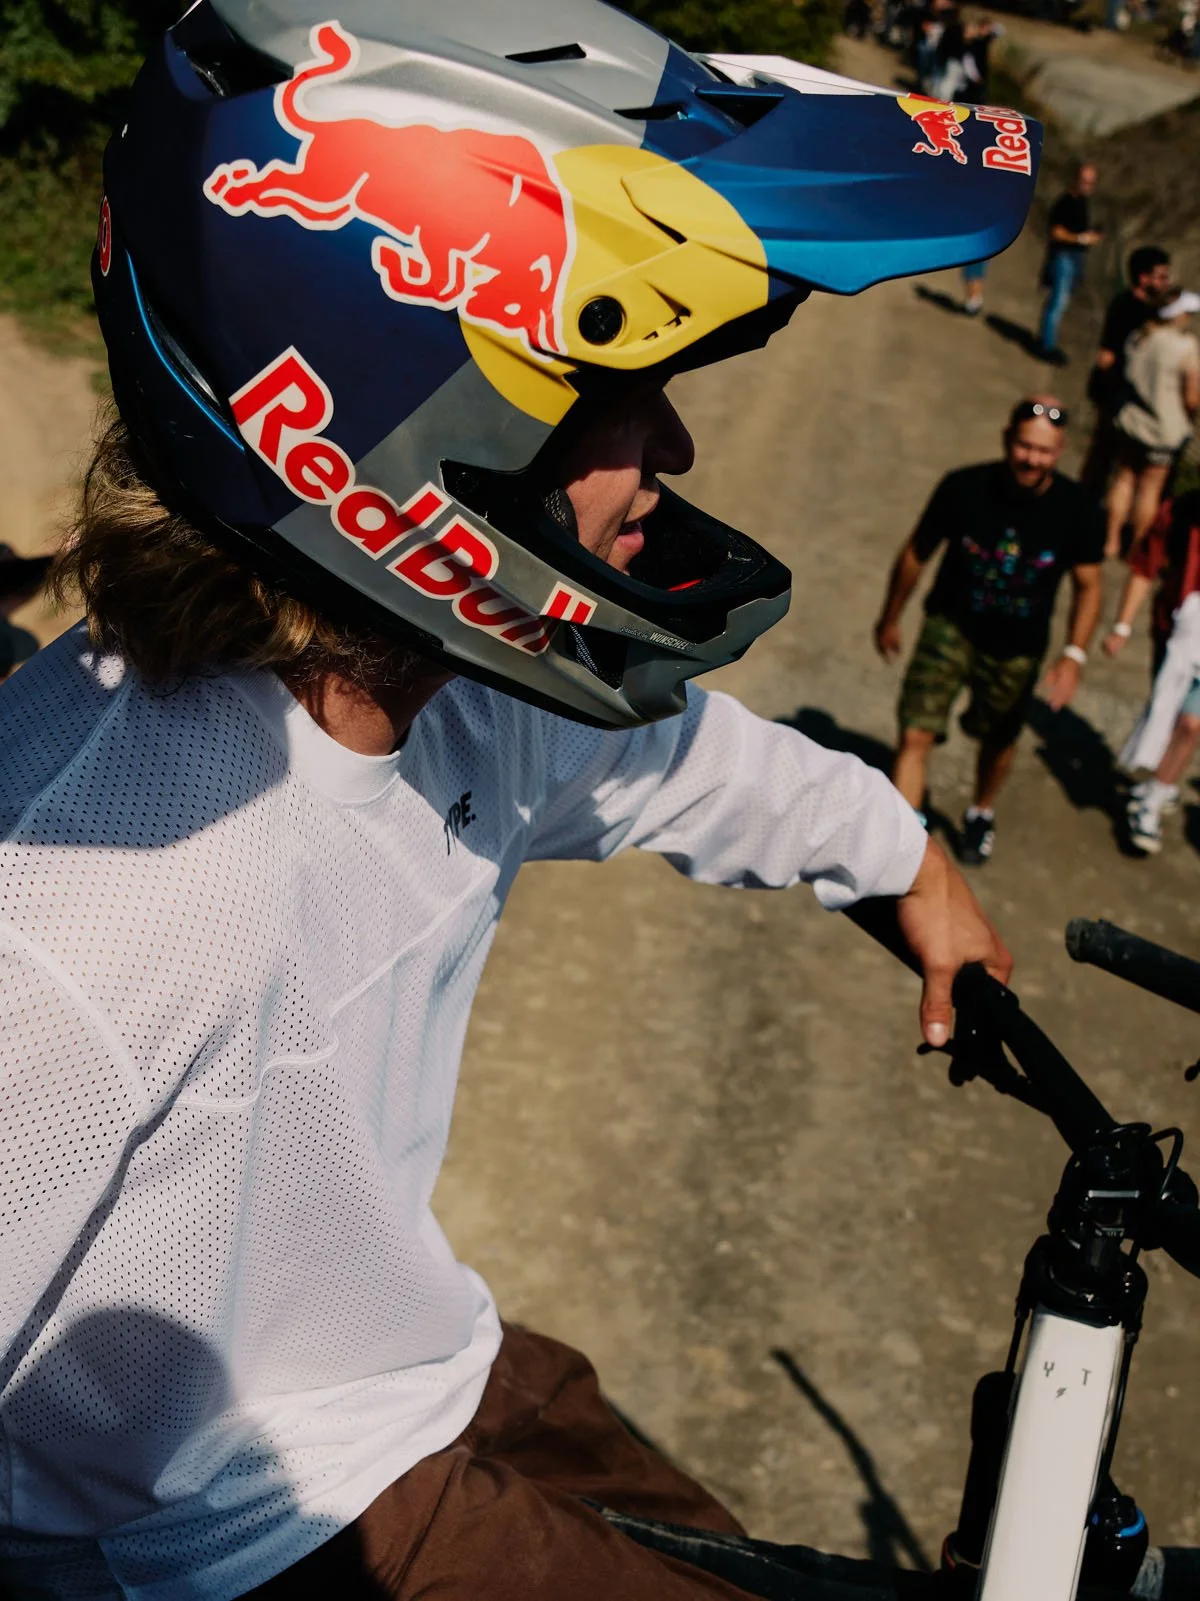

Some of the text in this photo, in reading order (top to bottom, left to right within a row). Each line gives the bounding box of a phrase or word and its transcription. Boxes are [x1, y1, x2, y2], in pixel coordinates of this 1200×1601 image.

[975, 112, 1031, 175] Red
[229, 347, 450, 560] Red
[649, 631, 689, 650] WUNSCHEL
